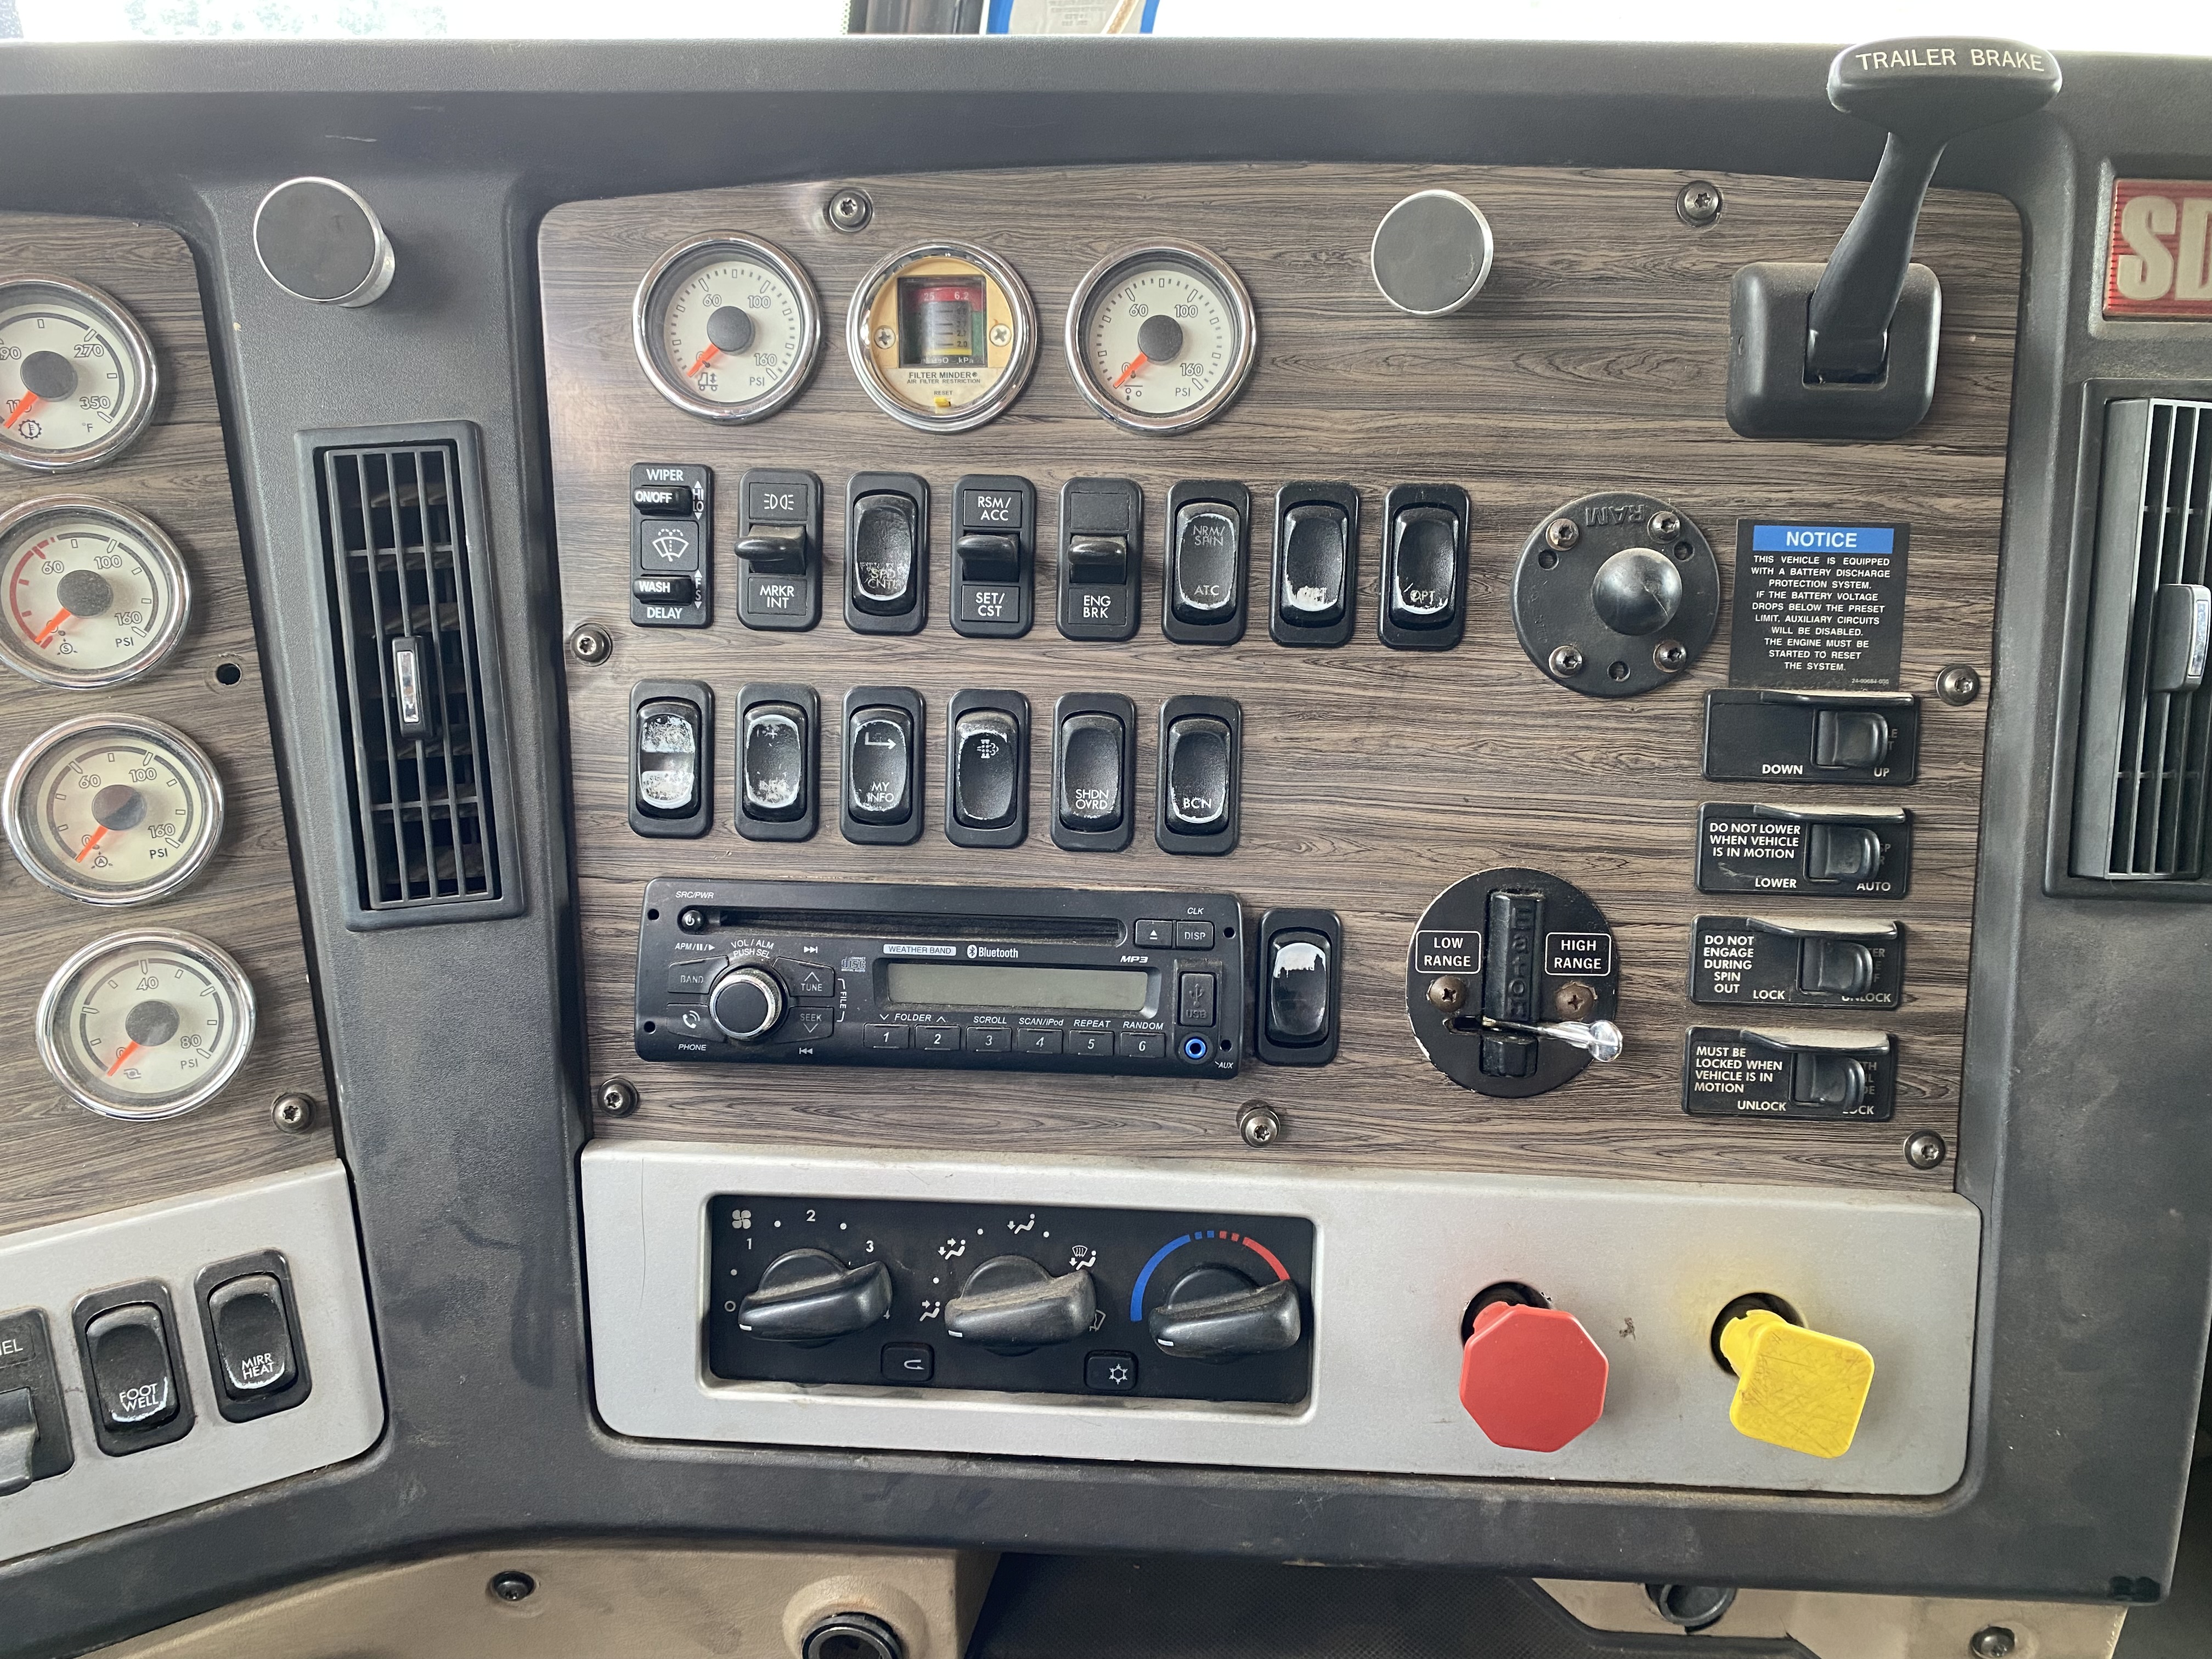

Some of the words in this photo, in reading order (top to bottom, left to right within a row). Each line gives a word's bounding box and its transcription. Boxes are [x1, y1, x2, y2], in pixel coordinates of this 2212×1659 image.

[1856, 48, 1956, 70] TRAILER
[1971, 49, 2045, 71] BRAKE
[703, 294, 722, 307] 60
[954, 291, 969, 300] 6.2
[748, 296, 771, 309] 100
[1129, 304, 1148, 317] 60
[1175, 304, 1198, 318] 100
[74, 344, 104, 358] 270
[754, 353, 777, 367] 160
[1180, 363, 1203, 376] 160
[749, 377, 765, 386] PSI
[1175, 387, 1190, 397] PSI
[80, 396, 110, 409] 350
[646, 469, 684, 481] WIPER
[635, 492, 673, 503] ON/OFF
[692, 488, 704, 500] HI
[693, 501, 704, 512] LO
[978, 496, 1011, 509] RSM/
[980, 509, 1009, 521] ACC
[1585, 504, 1646, 527] RAM
[1193, 524, 1224, 537] NRM/
[1194, 535, 1223, 546] SPIN
[1786, 531, 1858, 548] NOTICE
[94, 555, 122, 569] 100
[1754, 555, 1774, 563] THIS
[1781, 556, 1820, 565] VEHICLE
[1843, 557, 1890, 566] EQUIPPED
[42, 561, 64, 575] 60
[1790, 568, 1831, 576] BATTERY
[1836, 569, 1891, 578] DISCHARGE
[639, 582, 670, 593] WASH
[1769, 579, 1827, 588] PROTECTION
[1832, 581, 1871, 589] SYSTEM.
[760, 585, 794, 597] MRKR
[1194, 585, 1220, 596] ATC
[1768, 591, 1786, 599] THE
[1791, 592, 1832, 600] BATTERY
[1837, 593, 1878, 601] VOLTAGE
[768, 597, 789, 608] INT
[975, 592, 1005, 605] SET/
[1083, 595, 1111, 606] ENG
[647, 607, 682, 619] DELAY
[978, 605, 1002, 617] CST
[1082, 607, 1108, 619] BRK
[1752, 602, 1784, 611] DROPS
[1788, 603, 1821, 612] BELOW
[1826, 604, 1843, 612] THE
[1849, 605, 1885, 613] PRESET
[115, 611, 143, 626] 160
[1785, 616, 1832, 624] AUXILIARY
[1837, 617, 1880, 625] CIRCUITS
[1815, 628, 1863, 636] DISABLED.
[116, 638, 134, 648] PSI
[1787, 639, 1821, 647] ENGINE
[1826, 640, 1852, 648] MUST
[1769, 650, 1810, 658] STARTED
[1831, 651, 1861, 659] RESET
[1807, 663, 1846, 671] SYSTEM.
[129, 768, 157, 782] 100
[1762, 764, 1803, 775] DOWN
[1874, 768, 1889, 777] UP
[79, 775, 101, 789] 60
[871, 781, 890, 792] MY
[867, 792, 894, 803] INFO
[1075, 789, 1109, 799] SHDN
[1075, 799, 1108, 810] OVRD
[1183, 798, 1212, 809] BCN
[148, 823, 176, 839] 160
[1709, 823, 1728, 833] DO
[1731, 823, 1757, 833] NOT
[1760, 824, 1801, 834] LOWER
[1710, 835, 1747, 845] WHEN
[1751, 836, 1799, 847] VEHICLE
[150, 849, 168, 859] PSI
[1713, 847, 1723, 857] IS
[1727, 848, 1740, 857] IN
[1743, 848, 1795, 859] MOTION
[1754, 878, 1797, 888] LOWER
[1857, 883, 1891, 891] AUTO
[675, 891, 714, 899] SRC/PWR
[1184, 932, 1206, 940] DISP
[1705, 935, 1723, 945] DO
[1727, 936, 1754, 946] NOT
[731, 940, 749, 949] VOL
[755, 939, 774, 950] ALM
[1434, 937, 1463, 949] LOW
[1561, 940, 1596, 951] HIGH
[733, 949, 755, 958] PUSH
[756, 949, 771, 959] SEL
[889, 945, 927, 953] WEATHER
[978, 946, 1019, 958] Bluetooth
[1703, 947, 1754, 958] ENGAGE
[1424, 955, 1471, 967] RANGE
[1554, 957, 1601, 969] RANGE
[1704, 959, 1752, 970] DURING
[680, 975, 704, 983] BAND
[1714, 972, 1741, 981] SPIN
[137, 977, 159, 991] 40
[800, 983, 822, 992] TUNE
[1714, 984, 1740, 994] OUT
[1753, 990, 1785, 1000] LOCK
[895, 1013, 932, 1022] FOLDER
[973, 1016, 1007, 1024] SCROLL
[1019, 1017, 1064, 1026] SCAN/iPod
[1074, 1019, 1111, 1028] REPEAT
[1123, 1021, 1164, 1030] RANDOM
[180, 1035, 202, 1049] 80
[1696, 1046, 1729, 1057] MUST
[1733, 1048, 1746, 1058] BE
[180, 1060, 199, 1070] PSI
[1696, 1058, 1742, 1069] LOCKED
[1746, 1060, 1782, 1071] WHEN
[1695, 1070, 1742, 1081] VEHICLE
[1746, 1072, 1756, 1081] IS
[1759, 1073, 1773, 1082] IN
[1694, 1082, 1744, 1093] MOTION
[1737, 1101, 1786, 1111] UNLOCK
[241, 1352, 272, 1371] MIRR
[242, 1363, 274, 1380] HEAT
[119, 1383, 157, 1403] FOOT
[122, 1394, 159, 1412] WELL
